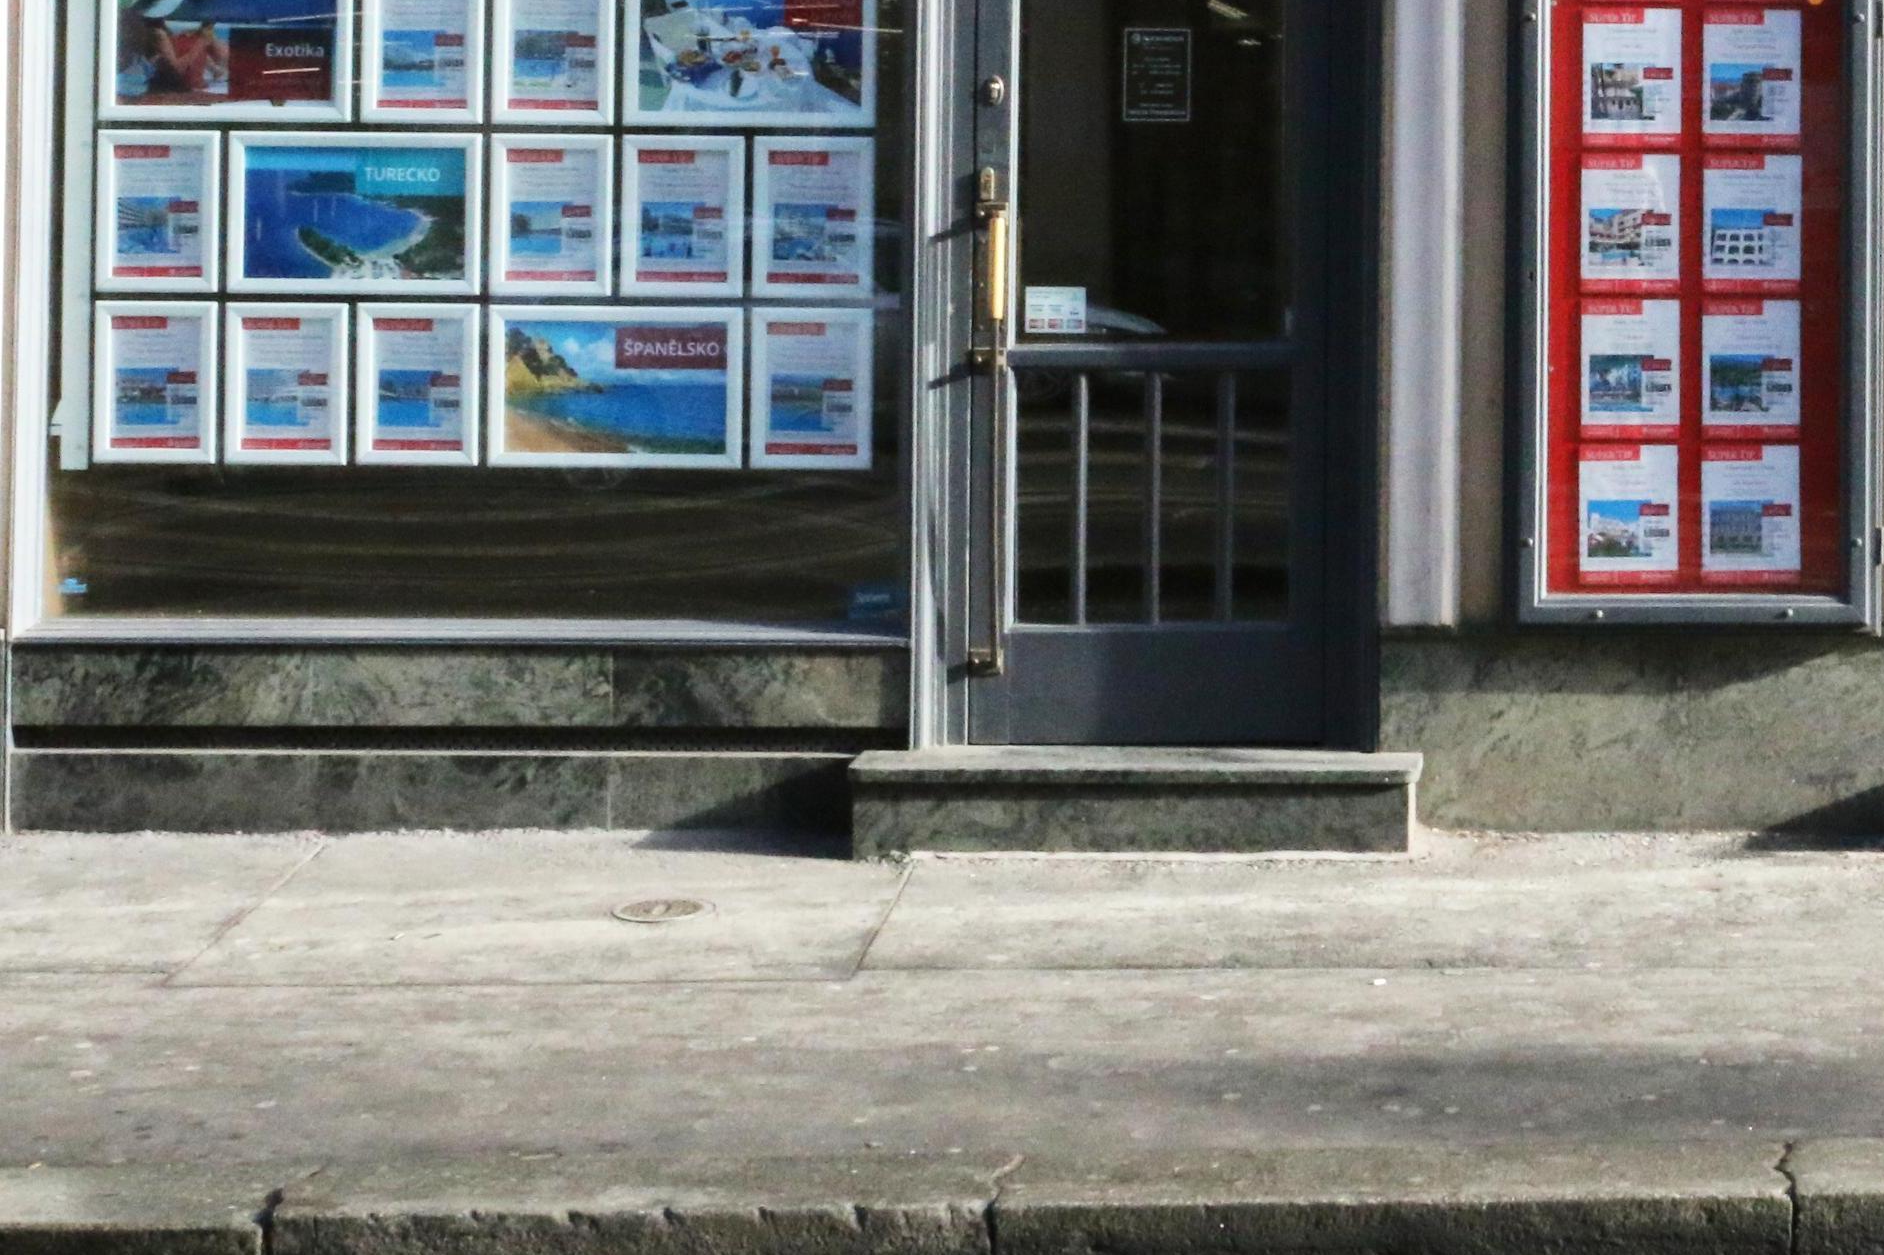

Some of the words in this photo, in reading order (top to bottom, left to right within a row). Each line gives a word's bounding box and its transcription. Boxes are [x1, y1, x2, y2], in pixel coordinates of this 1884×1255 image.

[265, 42, 325, 58] Exotika
[363, 165, 441, 183] TURECKO
[623, 337, 720, 357] ŠPANĚLSKO
